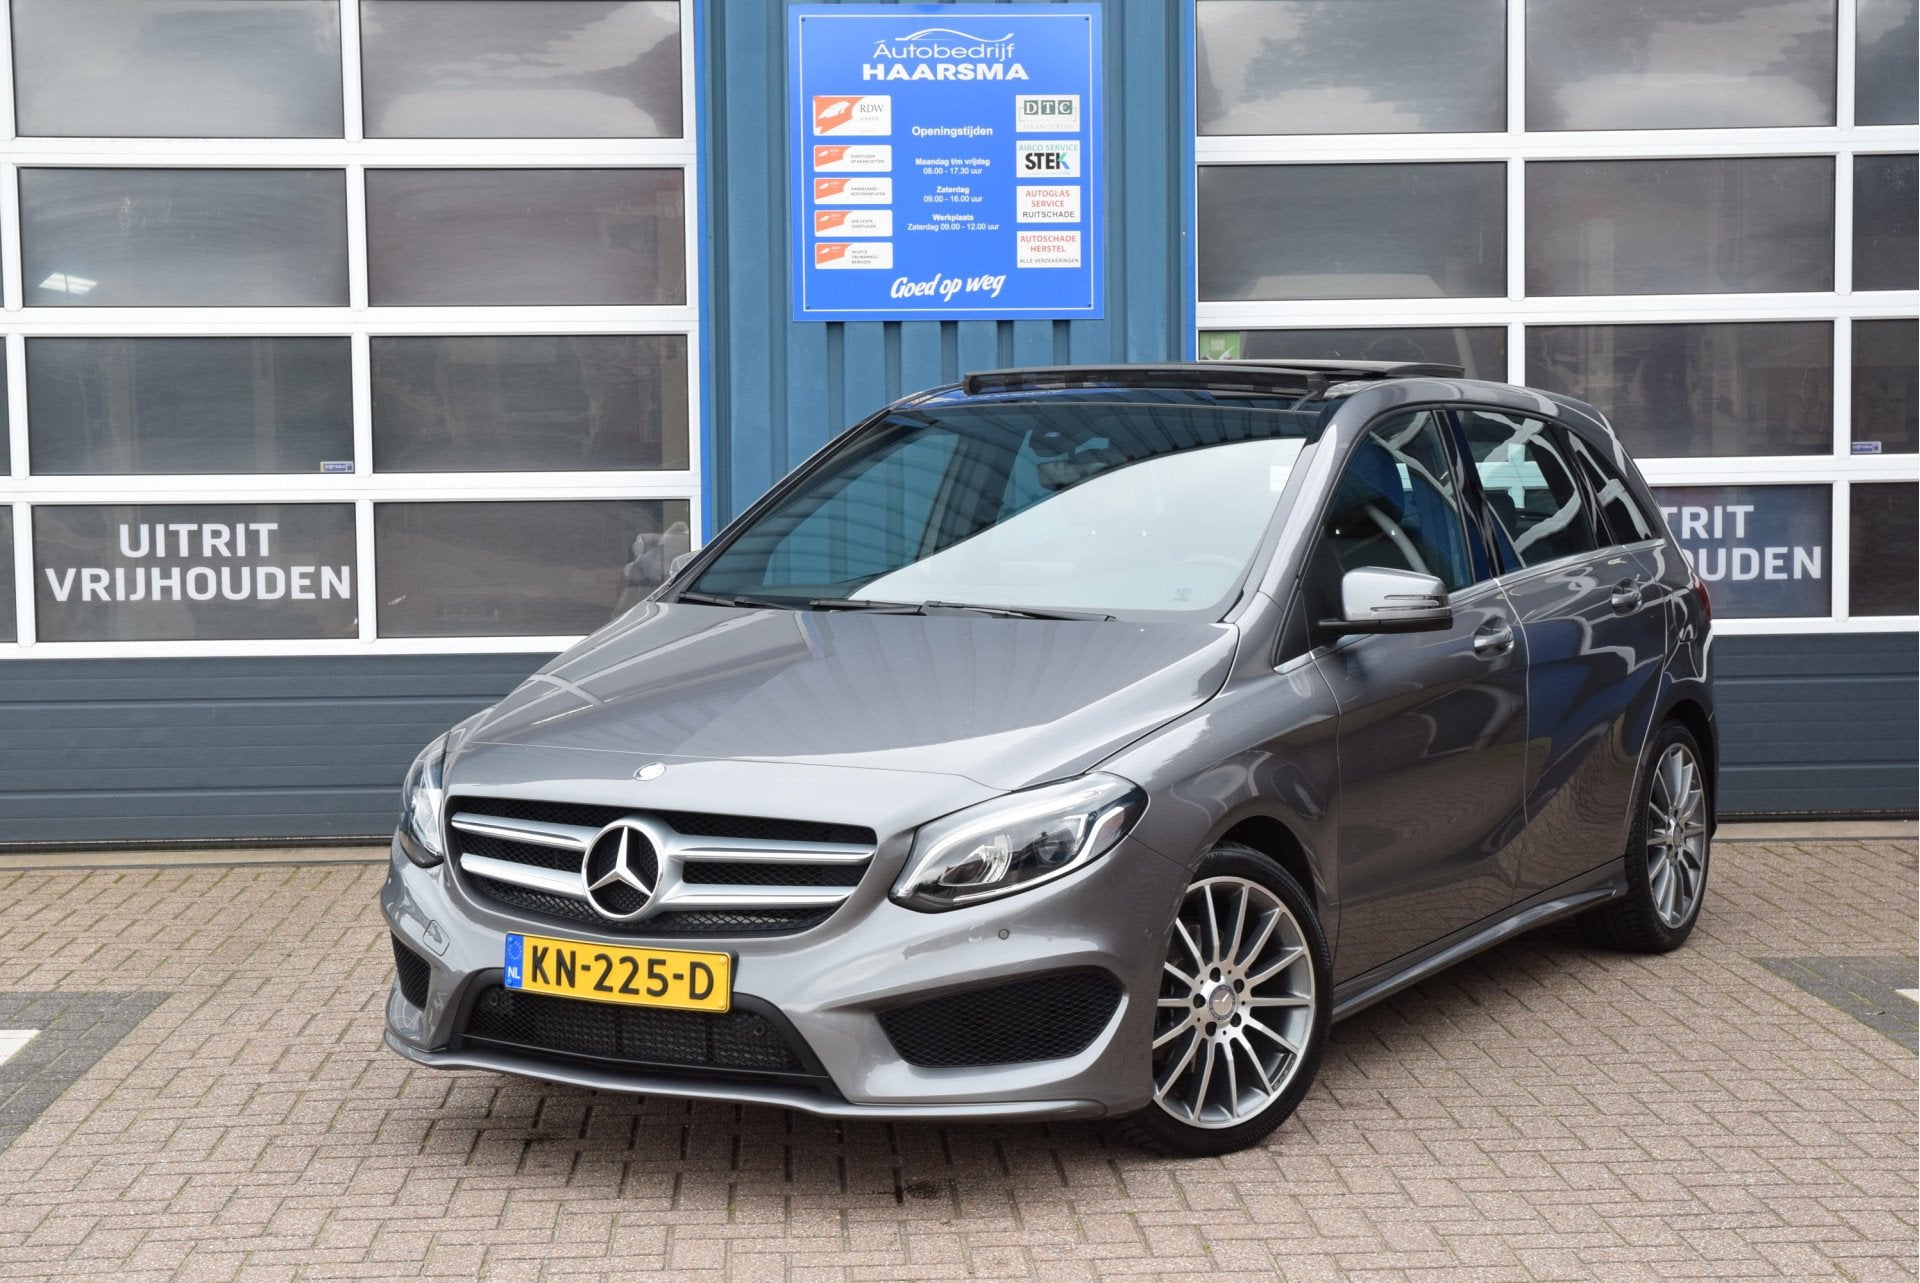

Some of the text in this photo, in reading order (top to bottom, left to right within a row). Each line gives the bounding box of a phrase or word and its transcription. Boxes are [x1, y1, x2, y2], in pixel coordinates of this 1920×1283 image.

[874, 42, 1014, 61] Autobedrijf
[862, 64, 1029, 80] HAARSMA
[860, 104, 884, 113] RDW
[912, 126, 993, 137] Openingstijden
[916, 158, 949, 166] Maandag
[965, 158, 990, 166] vrijdag
[1025, 152, 1070, 170] STEK
[891, 273, 1006, 302] Goed op weg
[119, 523, 278, 558] UITRIT
[45, 566, 350, 602] VRIJHOUDEN
[508, 967, 520, 980] NL
[531, 945, 714, 1000] KN-225-D
